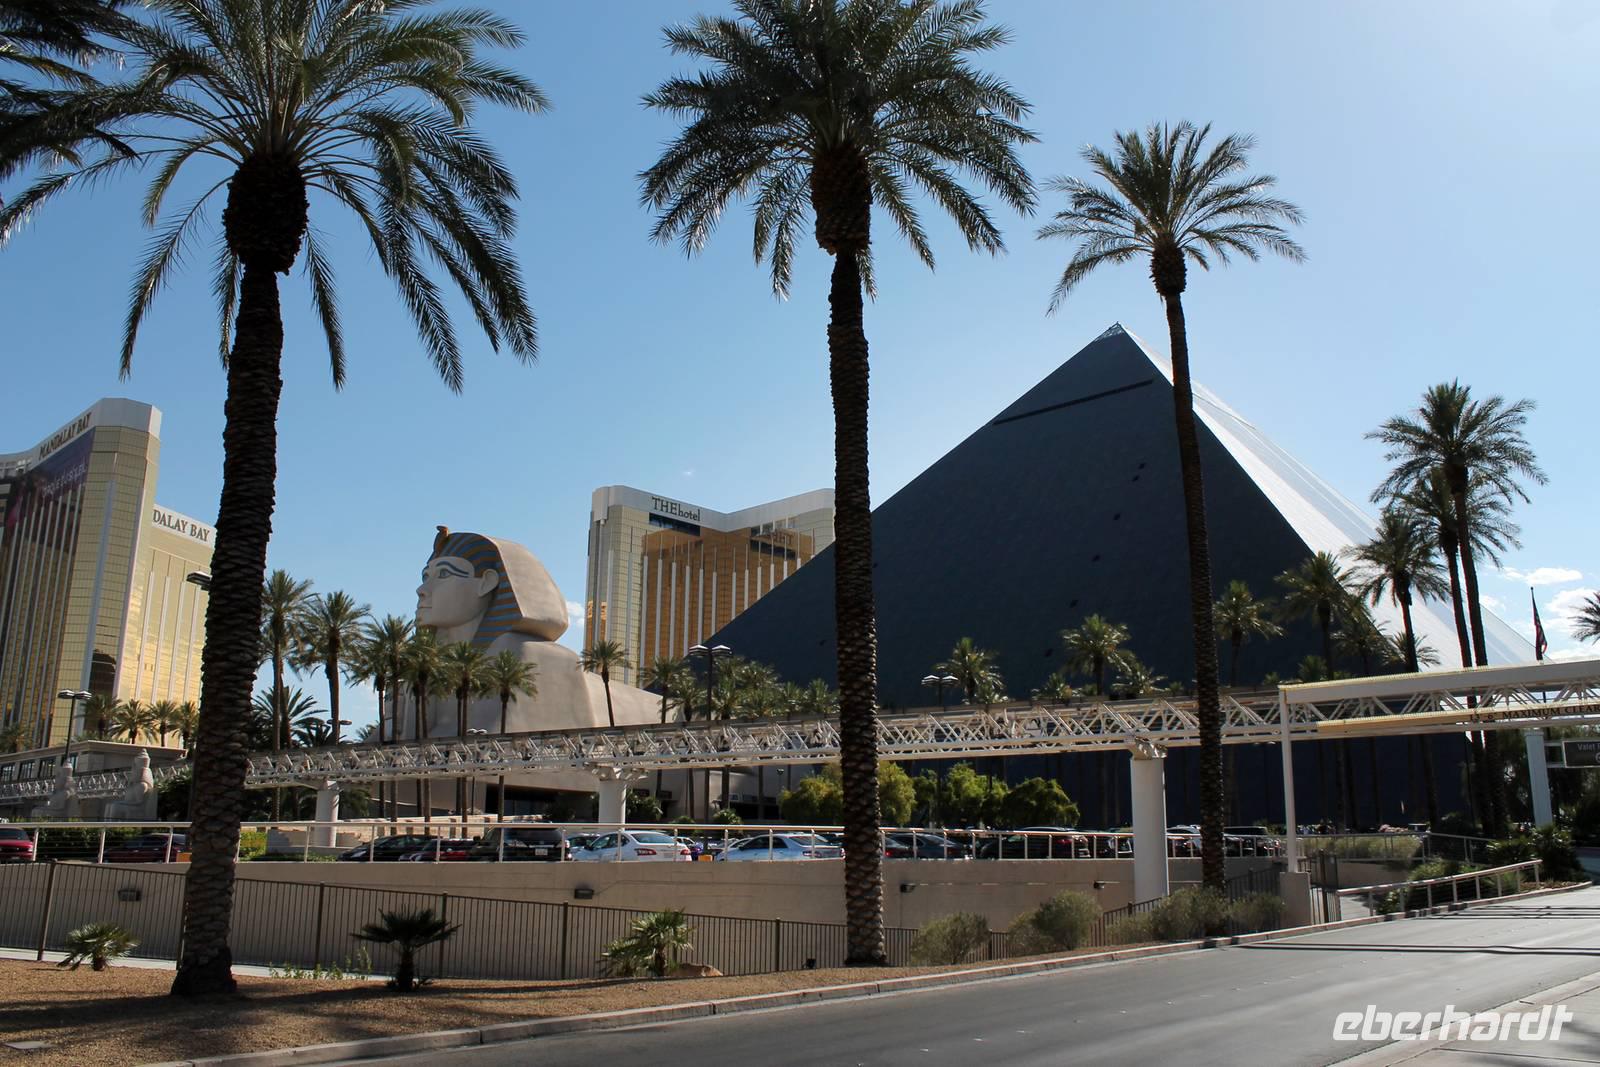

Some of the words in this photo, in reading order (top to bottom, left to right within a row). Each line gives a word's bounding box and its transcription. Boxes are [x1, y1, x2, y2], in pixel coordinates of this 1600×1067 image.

[652, 496, 700, 521] THEhotel
[190, 523, 210, 541] BAY
[1503, 707, 1560, 719] MAXIMUM
[1577, 743, 1595, 752] Valet
